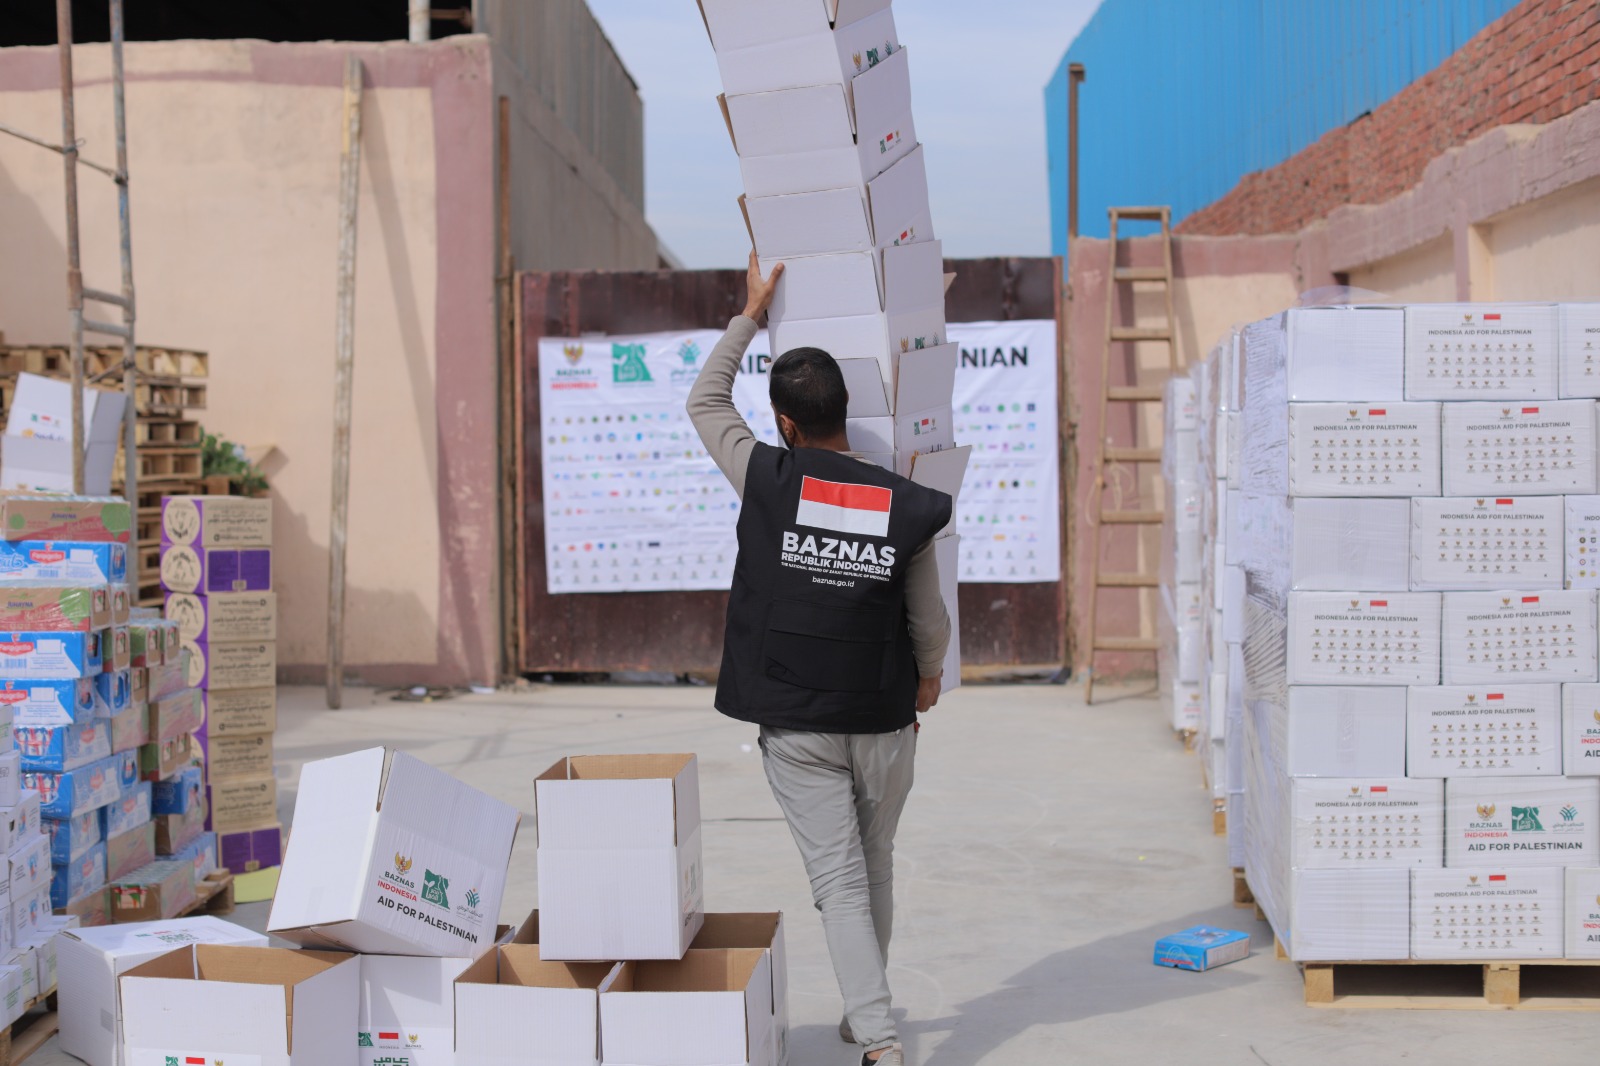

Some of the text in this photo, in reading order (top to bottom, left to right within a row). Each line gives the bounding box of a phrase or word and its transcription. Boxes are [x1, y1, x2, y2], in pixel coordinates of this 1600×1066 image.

[782, 531, 897, 566] BAZNAS
[781, 552, 892, 576] REPUBLIK INDONESIA
[812, 576, 855, 587] baznas.go.id
[1513, 842, 1583, 850] PALESTINIAN
[384, 871, 415, 888] BAZNAS
[378, 880, 417, 902] INDONESIA
[377, 896, 394, 908] AID
[397, 903, 416, 918] FOR
[418, 912, 478, 944] PALESTINIAN
